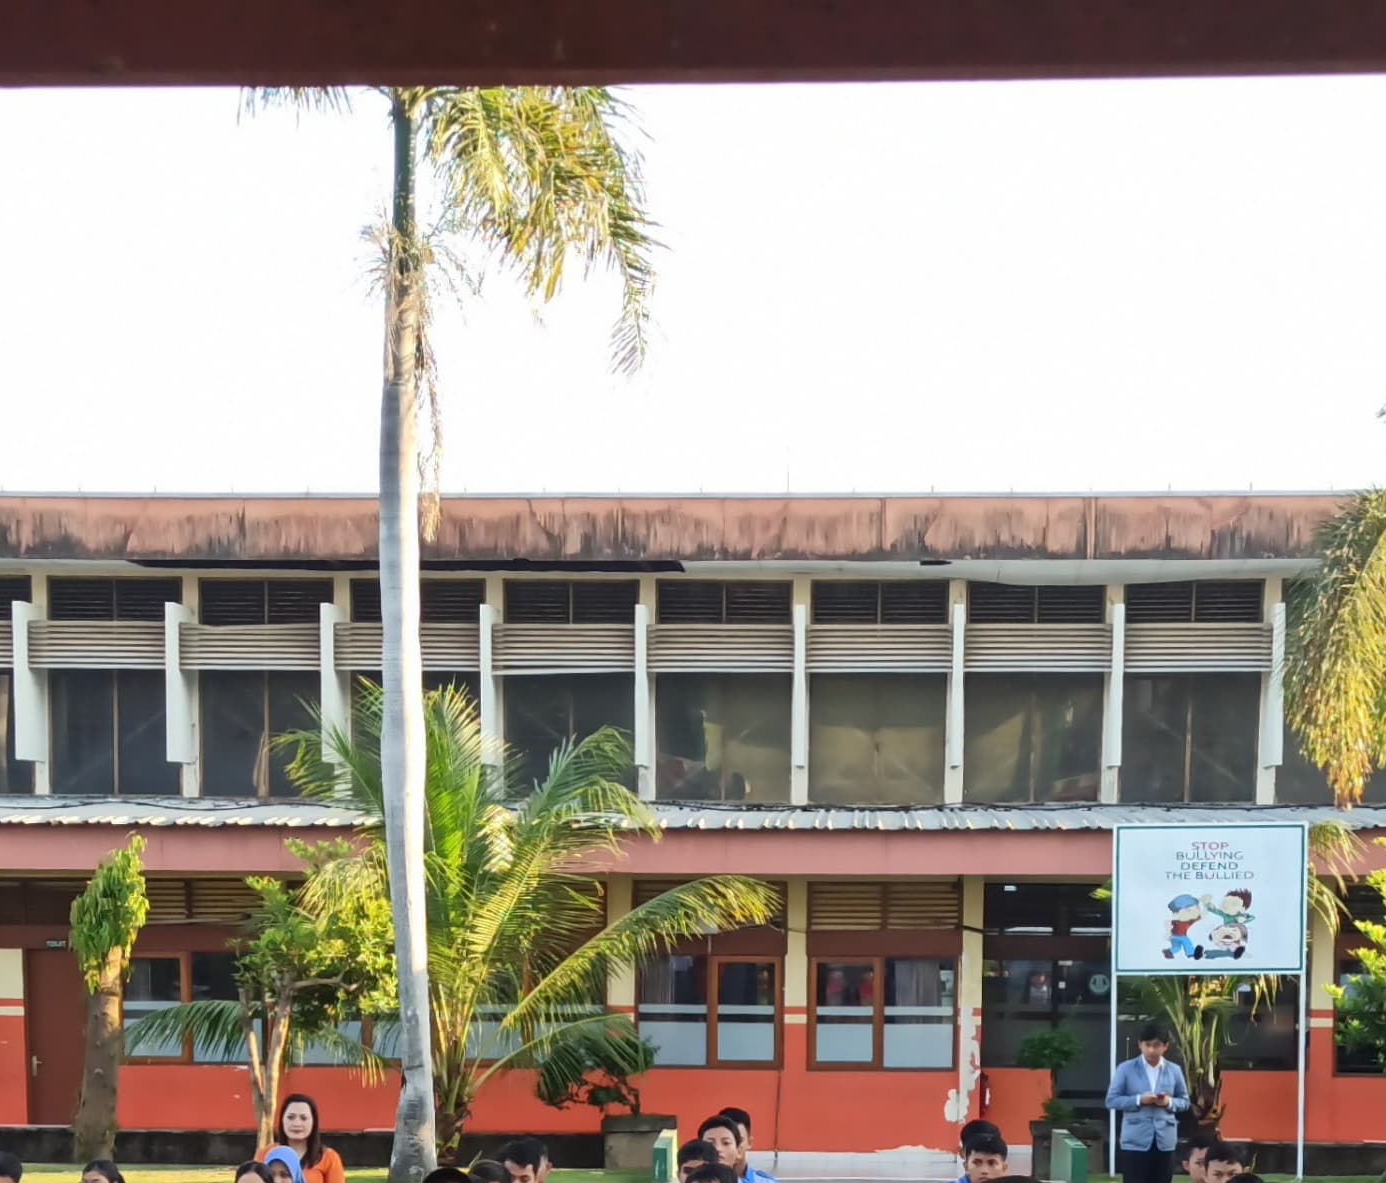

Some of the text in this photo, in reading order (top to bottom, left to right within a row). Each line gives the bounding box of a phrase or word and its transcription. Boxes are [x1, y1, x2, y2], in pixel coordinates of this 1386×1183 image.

[1191, 841, 1229, 850] STOP
[1176, 851, 1244, 860] BULLYING
[1180, 861, 1239, 870] DEFEND
[1165, 871, 1254, 880] THE BULLIED
